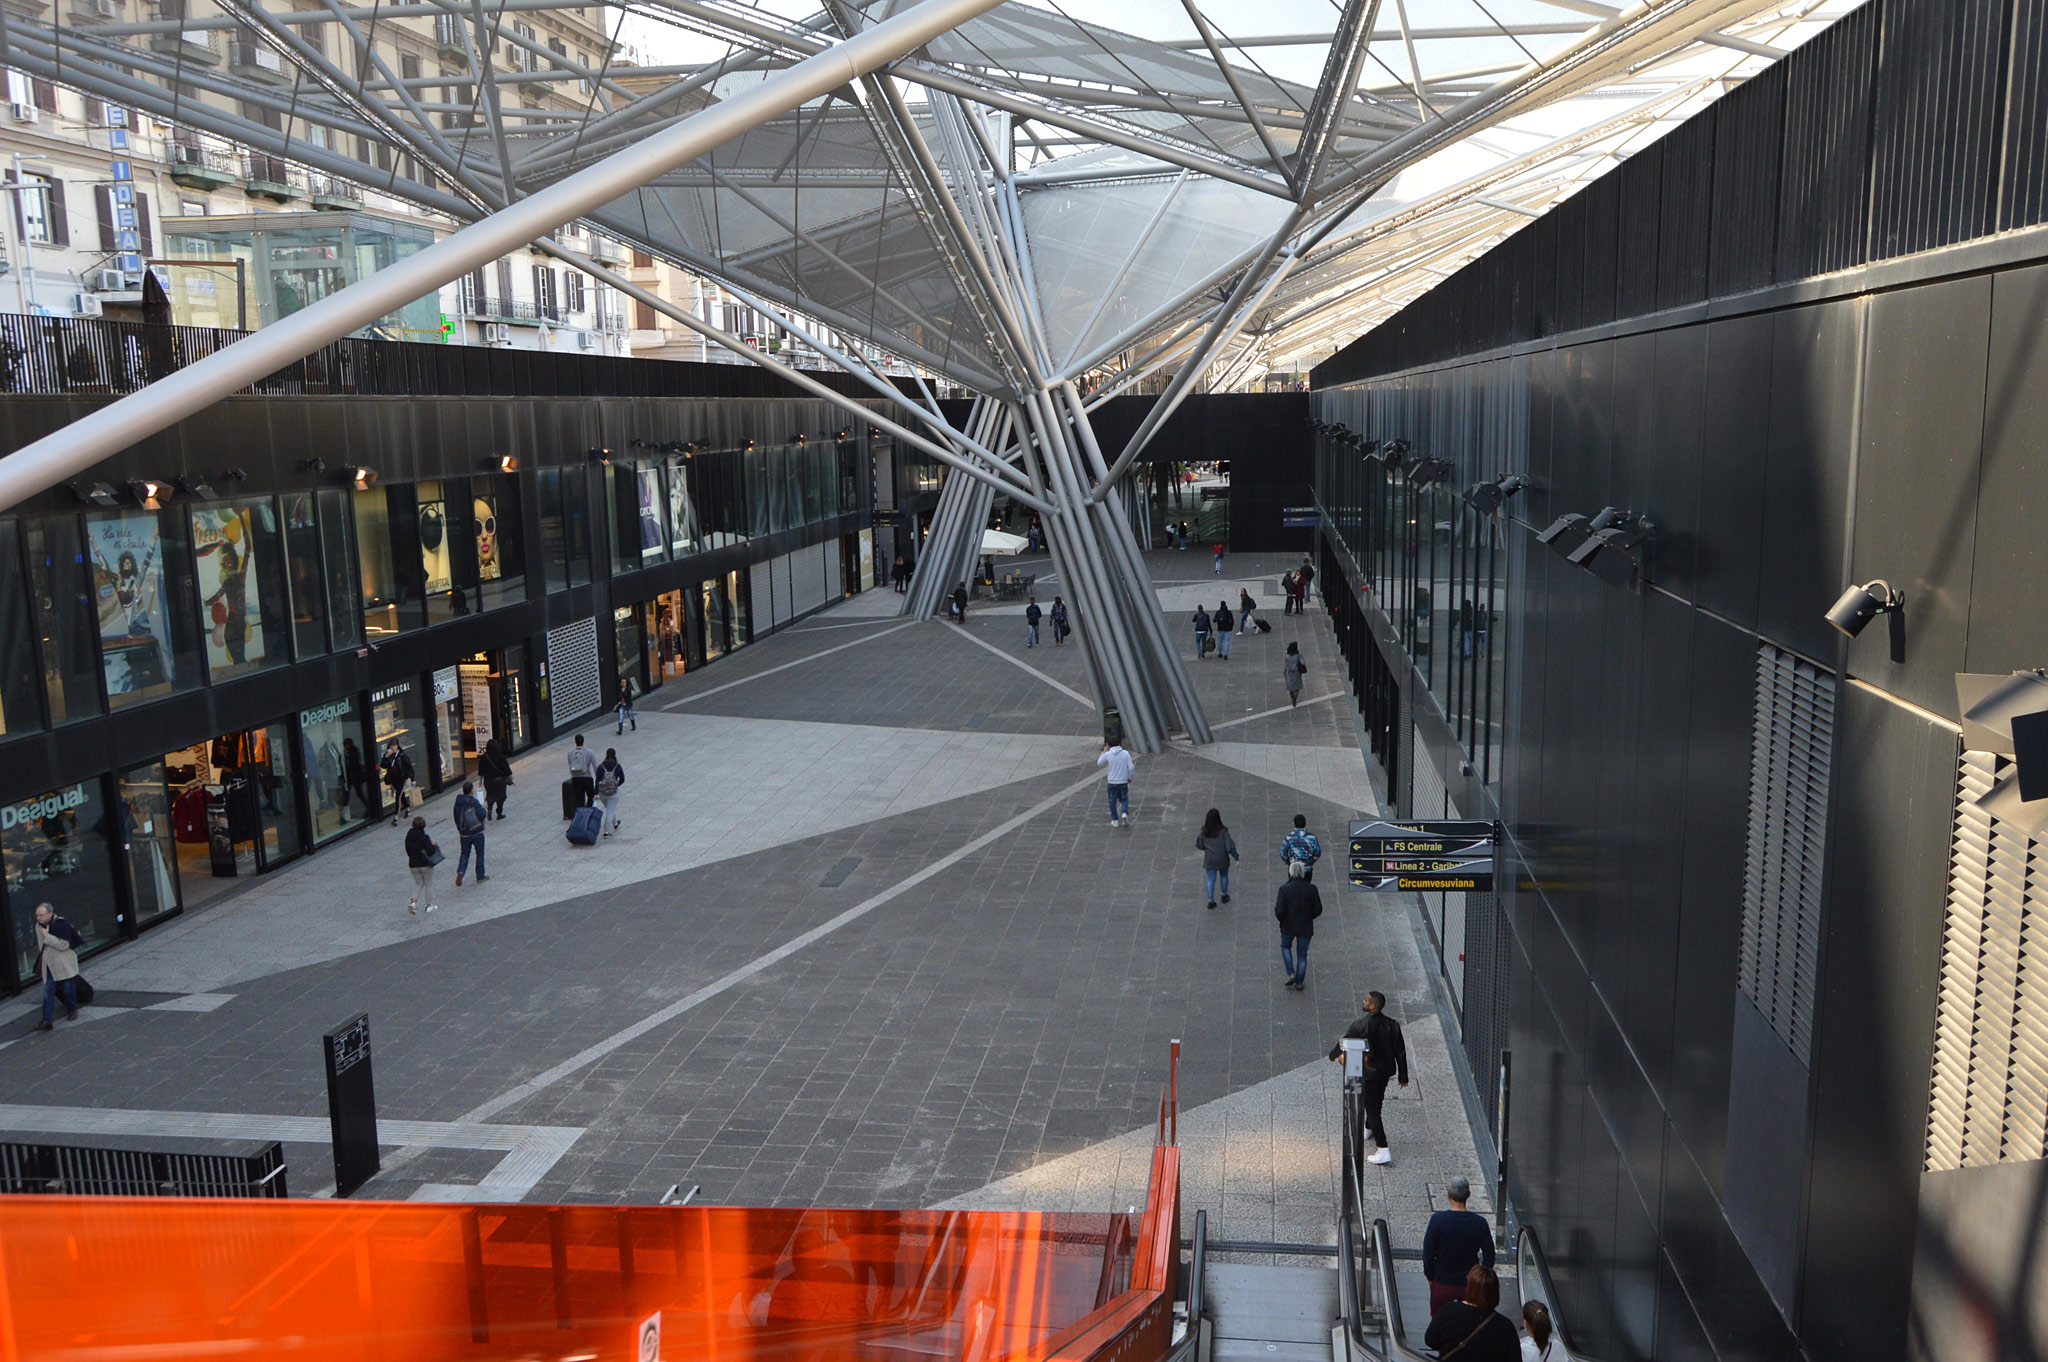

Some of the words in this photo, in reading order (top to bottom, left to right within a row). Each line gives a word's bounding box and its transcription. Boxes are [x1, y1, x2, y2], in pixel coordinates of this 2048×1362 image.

[116, 161, 139, 273] IDEAL
[386, 682, 411, 698] OPTICAL
[1394, 842, 1406, 851] FS
[1407, 842, 1443, 851] Centrale
[1394, 862, 1418, 871] Linea
[1419, 862, 1425, 871] 2
[1398, 878, 1475, 888] Circumvesuviana
